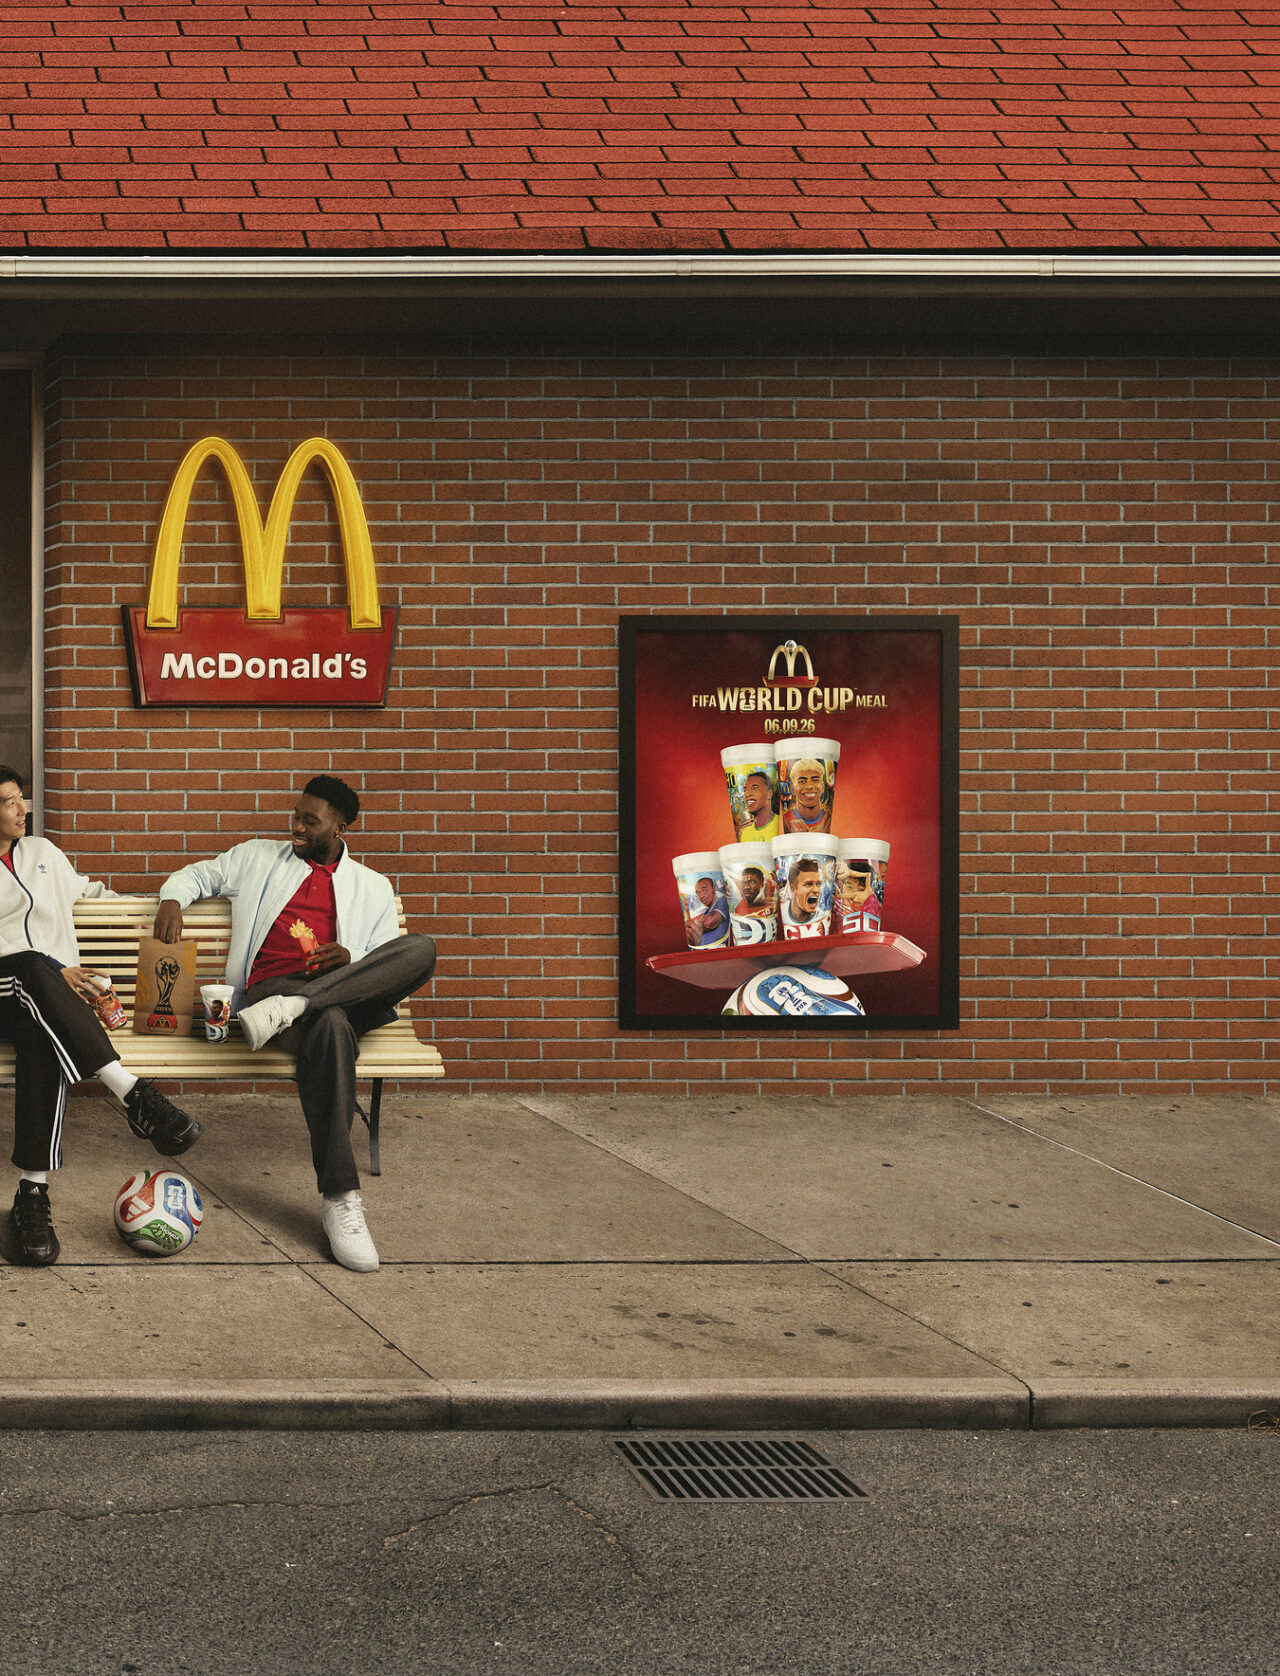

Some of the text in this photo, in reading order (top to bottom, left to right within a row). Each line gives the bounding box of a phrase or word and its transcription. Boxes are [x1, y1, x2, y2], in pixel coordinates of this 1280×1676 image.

[160, 653, 368, 680] McDonald's
[692, 687, 888, 713] FIFA WORLD CUP MEAL
[764, 718, 816, 734] 06.09.26
